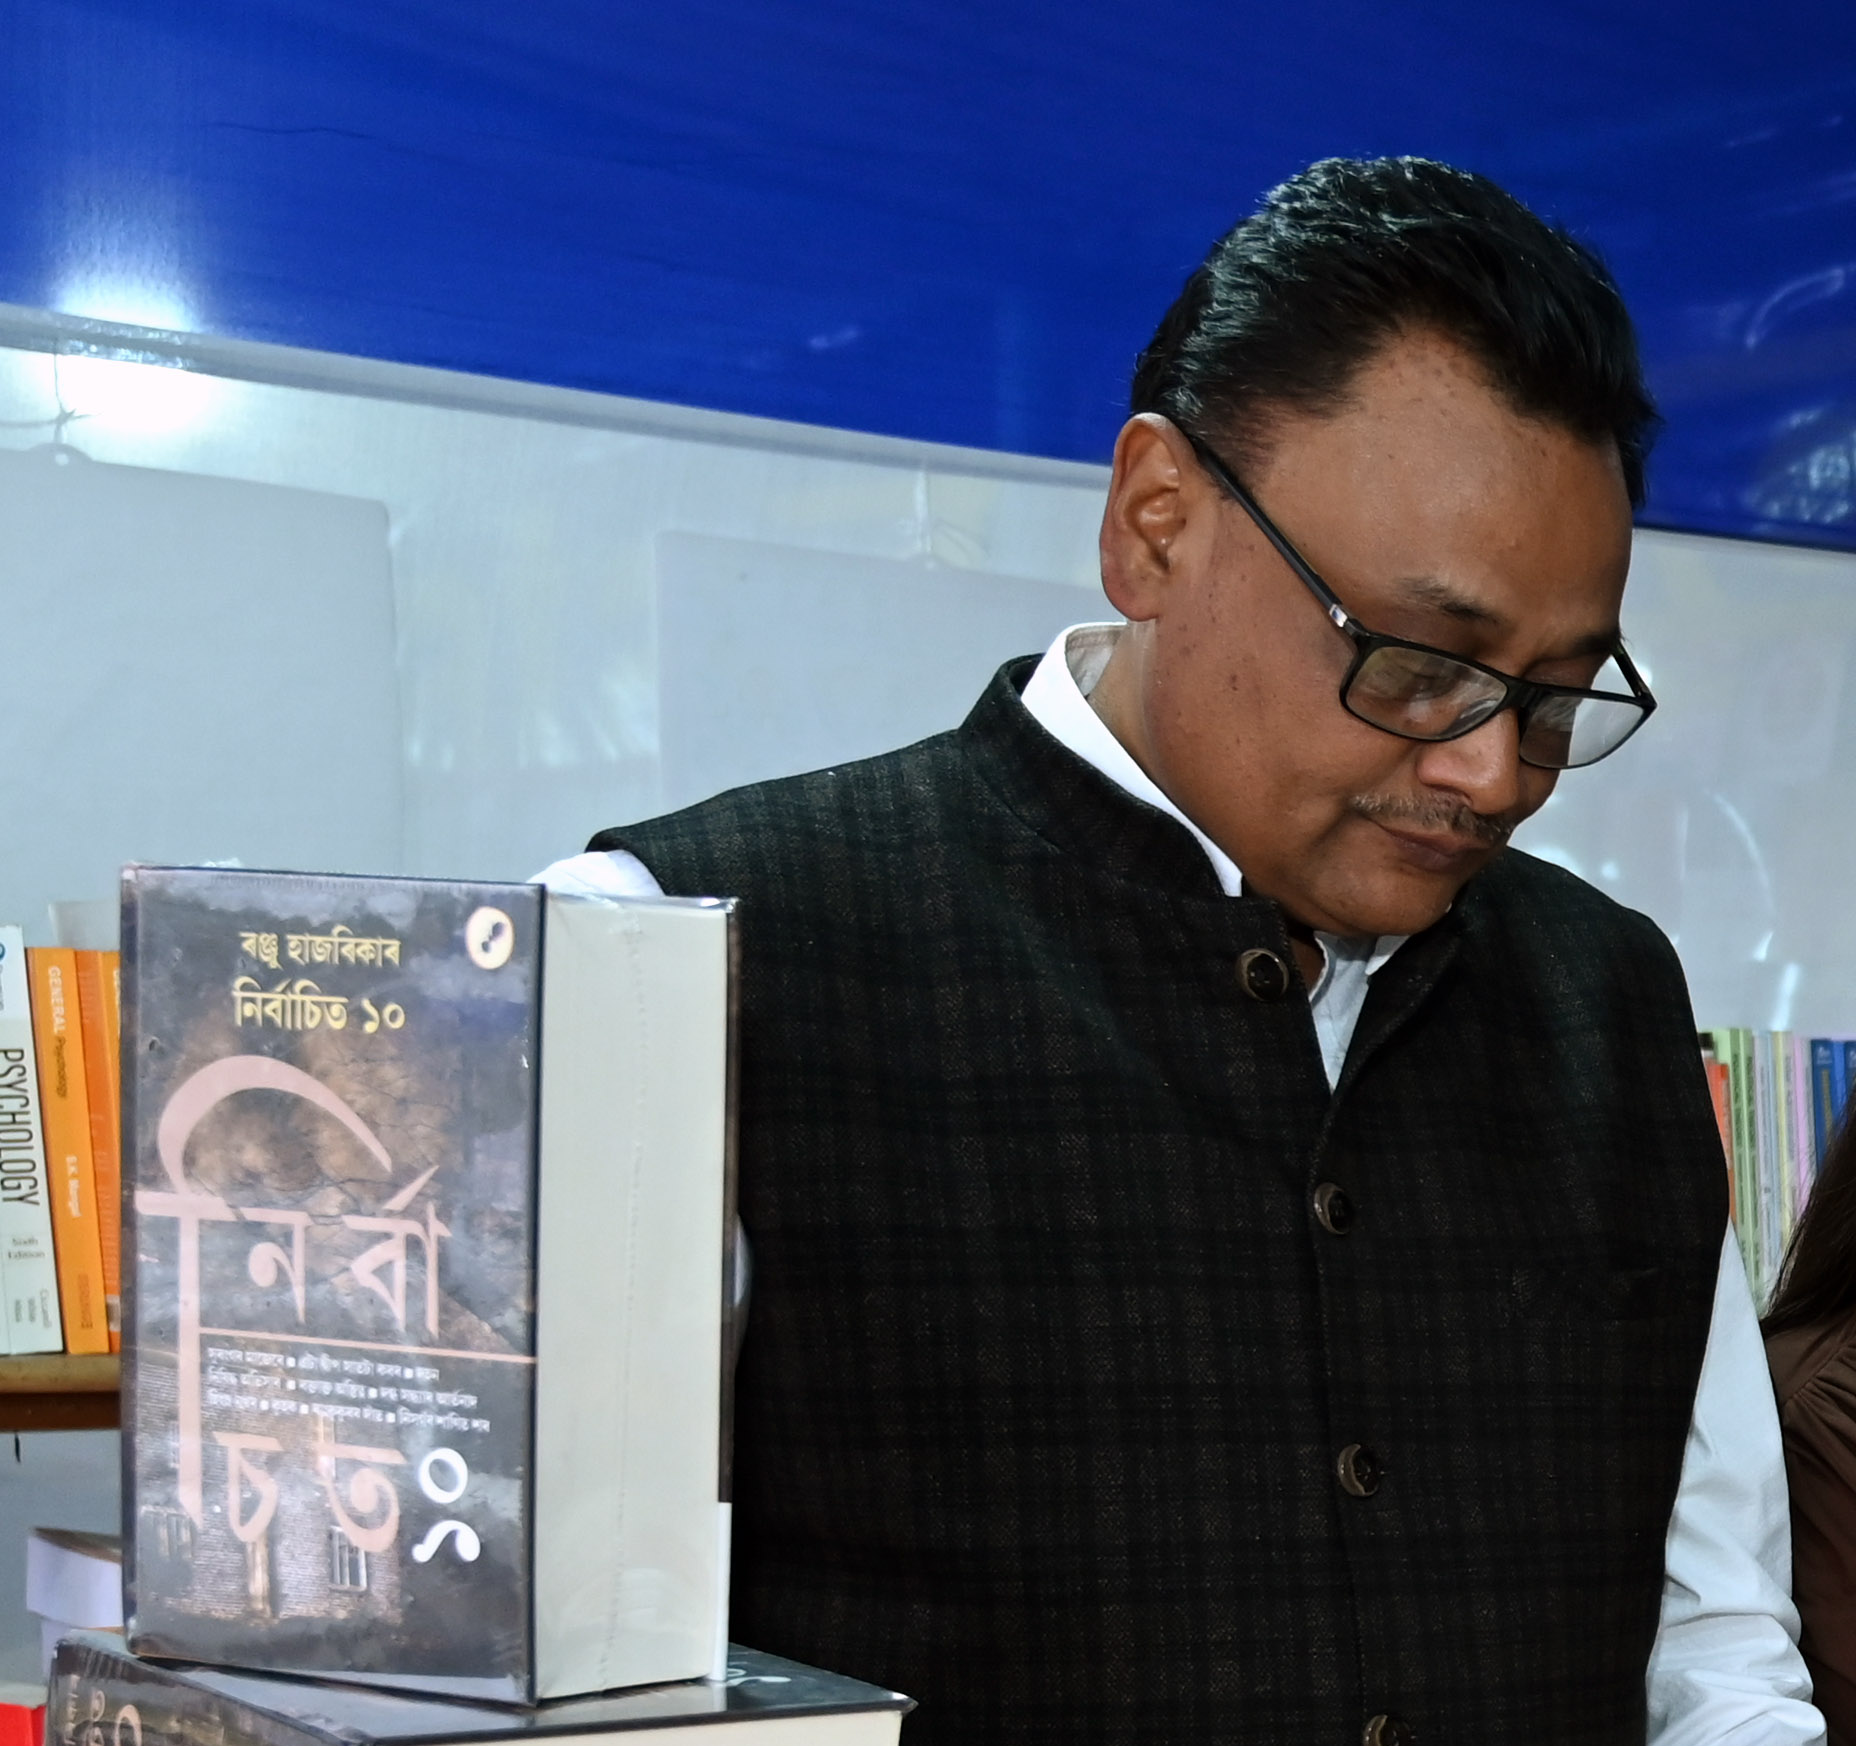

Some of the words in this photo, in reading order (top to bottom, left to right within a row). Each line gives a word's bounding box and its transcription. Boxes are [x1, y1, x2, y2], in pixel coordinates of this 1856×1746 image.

[48, 966, 66, 1034] GENERAL
[233, 981, 350, 1031] নিৰ্বাচিত
[360, 1000, 406, 1033] ১০
[0, 1048, 39, 1206] PSYCHOLOGY
